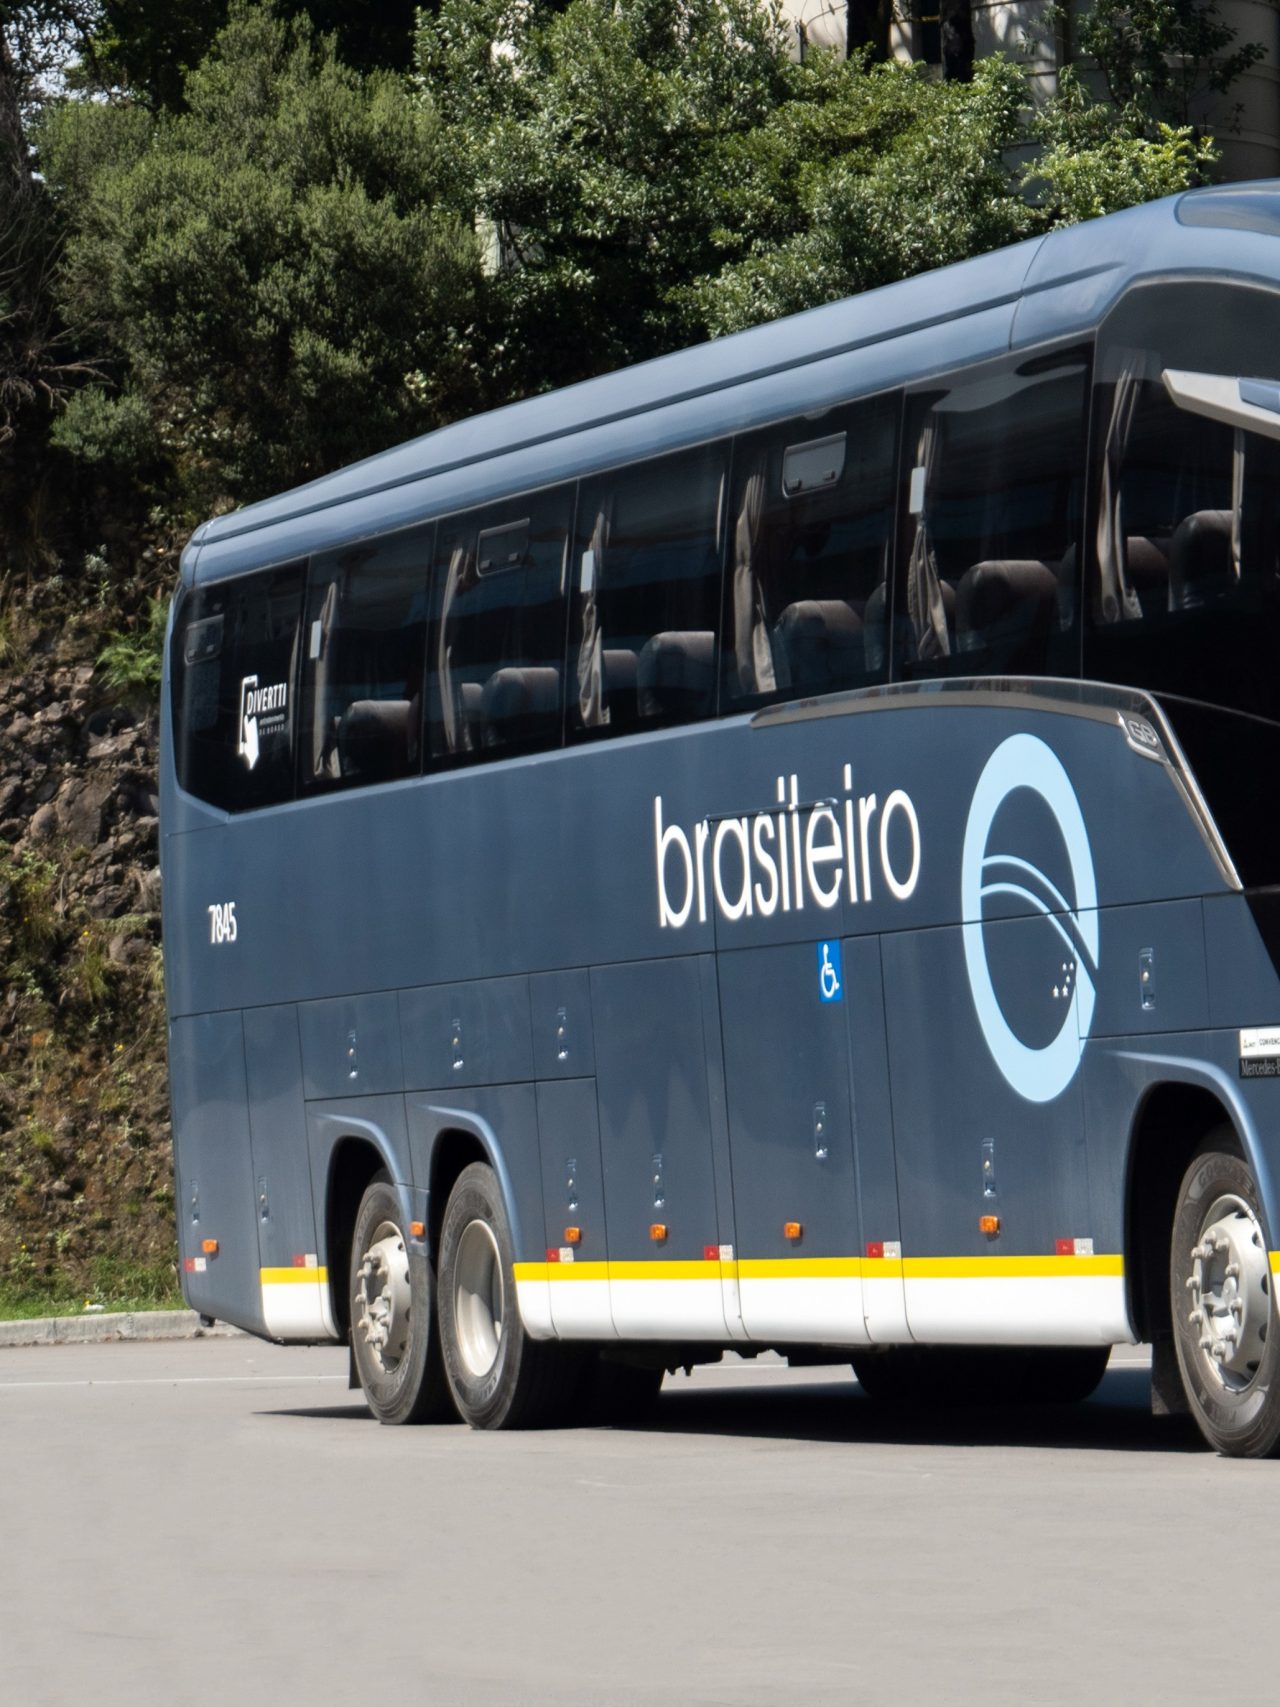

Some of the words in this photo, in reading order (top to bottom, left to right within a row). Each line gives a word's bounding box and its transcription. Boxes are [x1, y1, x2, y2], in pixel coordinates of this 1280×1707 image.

[247, 683, 287, 715] DIVERTTI
[655, 763, 921, 928] brasileiro
[208, 901, 238, 943] 7845
